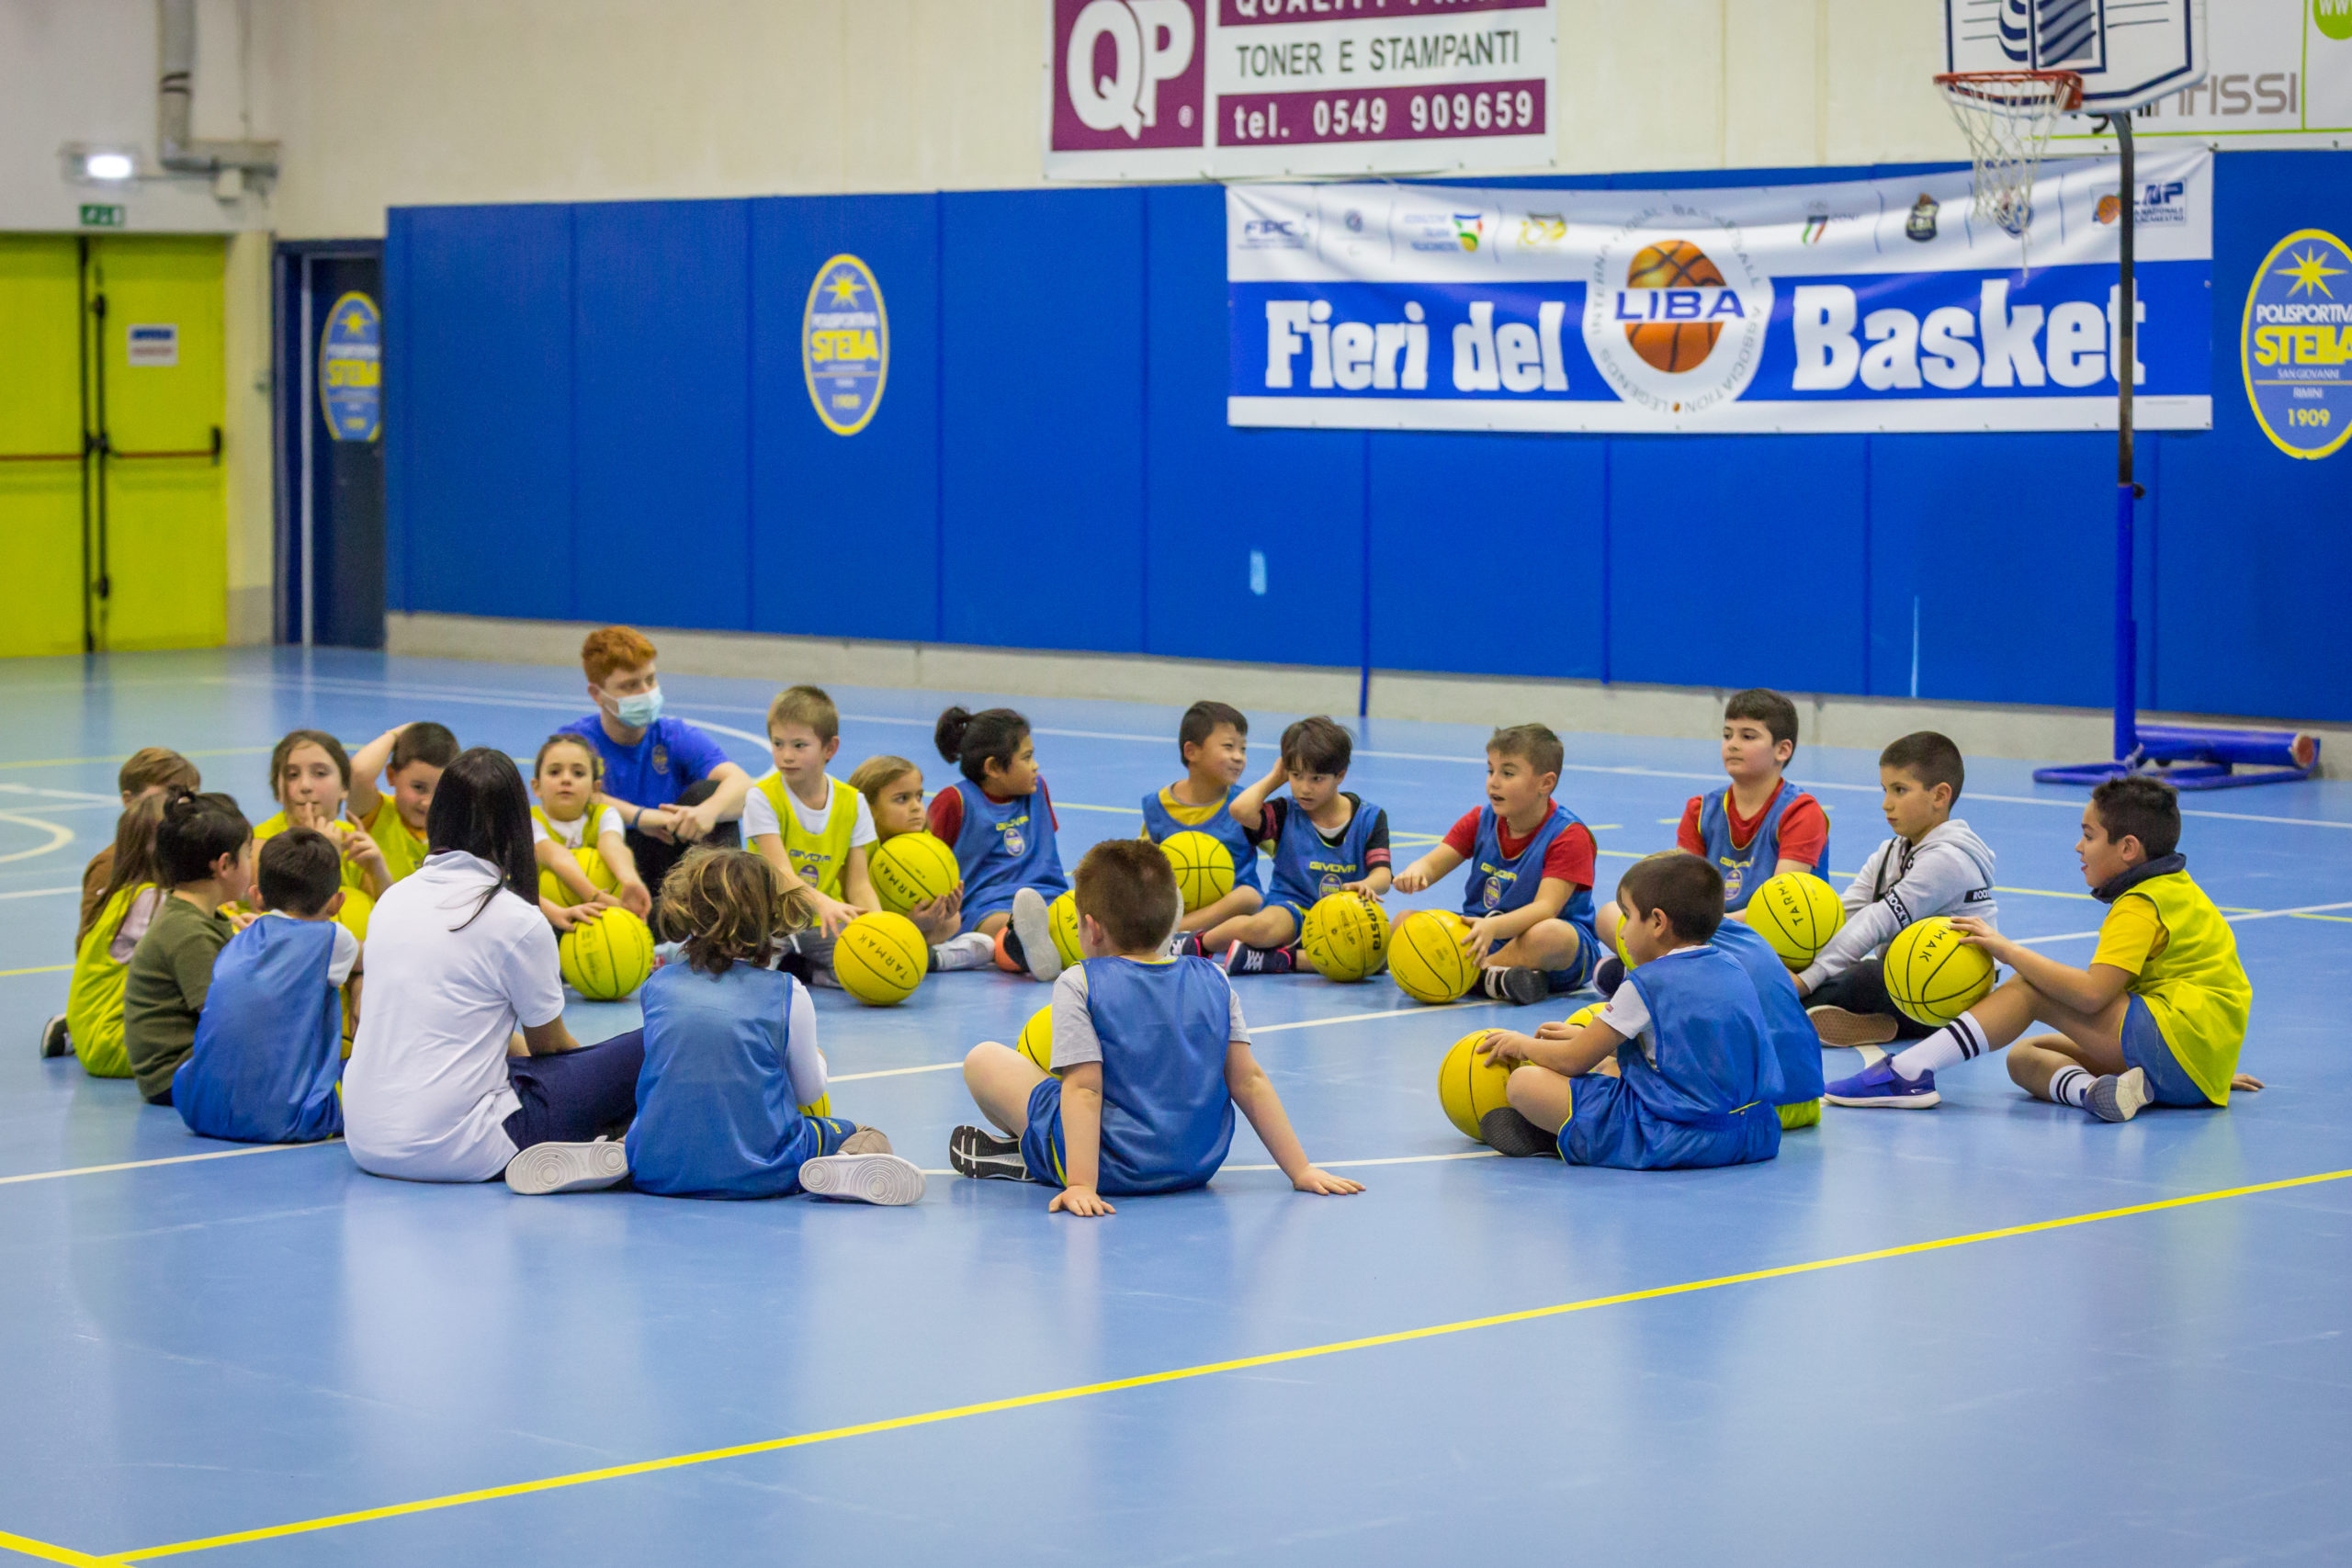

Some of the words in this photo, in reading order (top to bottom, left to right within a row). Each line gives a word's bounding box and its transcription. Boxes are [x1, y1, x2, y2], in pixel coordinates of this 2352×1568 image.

[1237, 42, 1321, 77] TONER
[1340, 39, 1353, 73] E
[1370, 30, 1520, 71] STAMPANTI
[1234, 104, 1290, 139] tel.
[1314, 96, 1387, 136] 0549
[1411, 90, 1533, 131] 909659
[1614, 289, 1746, 320] LIBA
[1265, 300, 1430, 389] Fieri
[1452, 301, 1569, 393] del
[1792, 278, 2146, 391] Basket
[2293, 387, 2324, 399] RIMINI
[2288, 408, 2331, 427] 1909
[1774, 879, 1804, 926] TARMA
[857, 933, 908, 980] TARMAK
